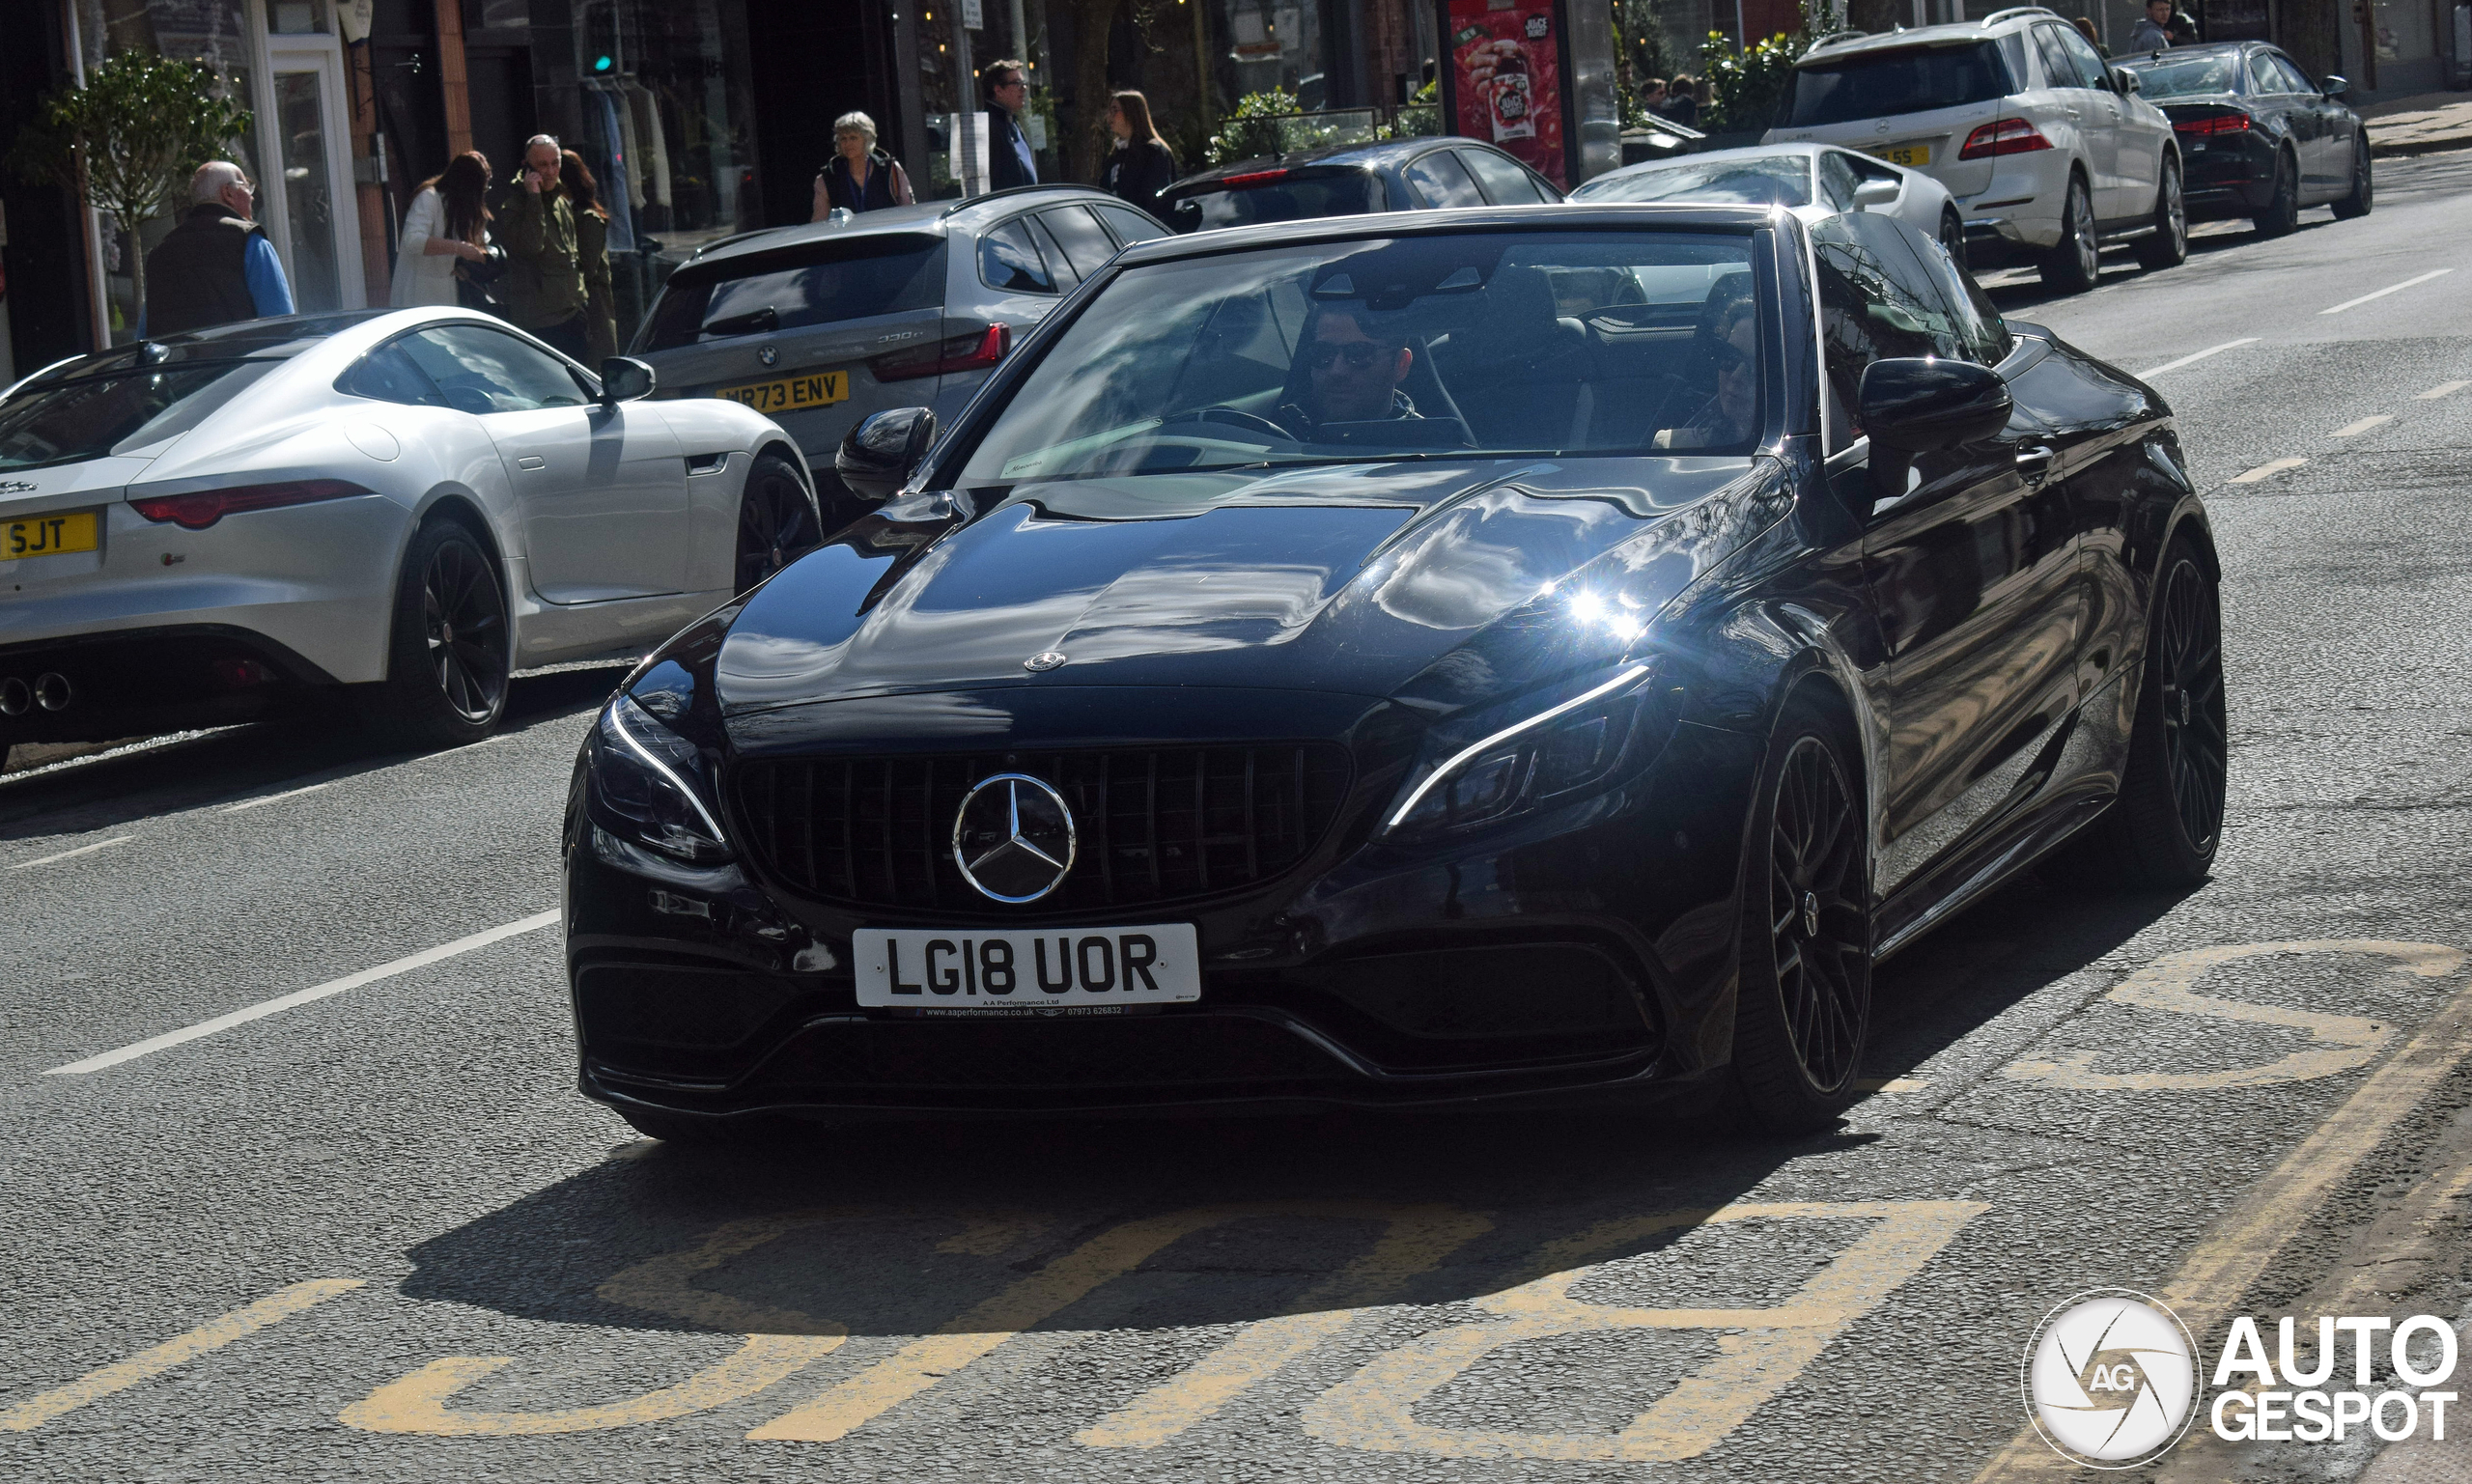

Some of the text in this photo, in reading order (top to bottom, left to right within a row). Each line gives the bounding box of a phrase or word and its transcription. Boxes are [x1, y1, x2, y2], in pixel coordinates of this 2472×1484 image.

[793, 376, 836, 403] ENV
[10, 518, 65, 552] SJT
[886, 934, 1160, 995] LG18 UOR
[926, 1007, 1034, 1017] www.aaperformance.co.uk
[1093, 1006, 1122, 1015] 626832
